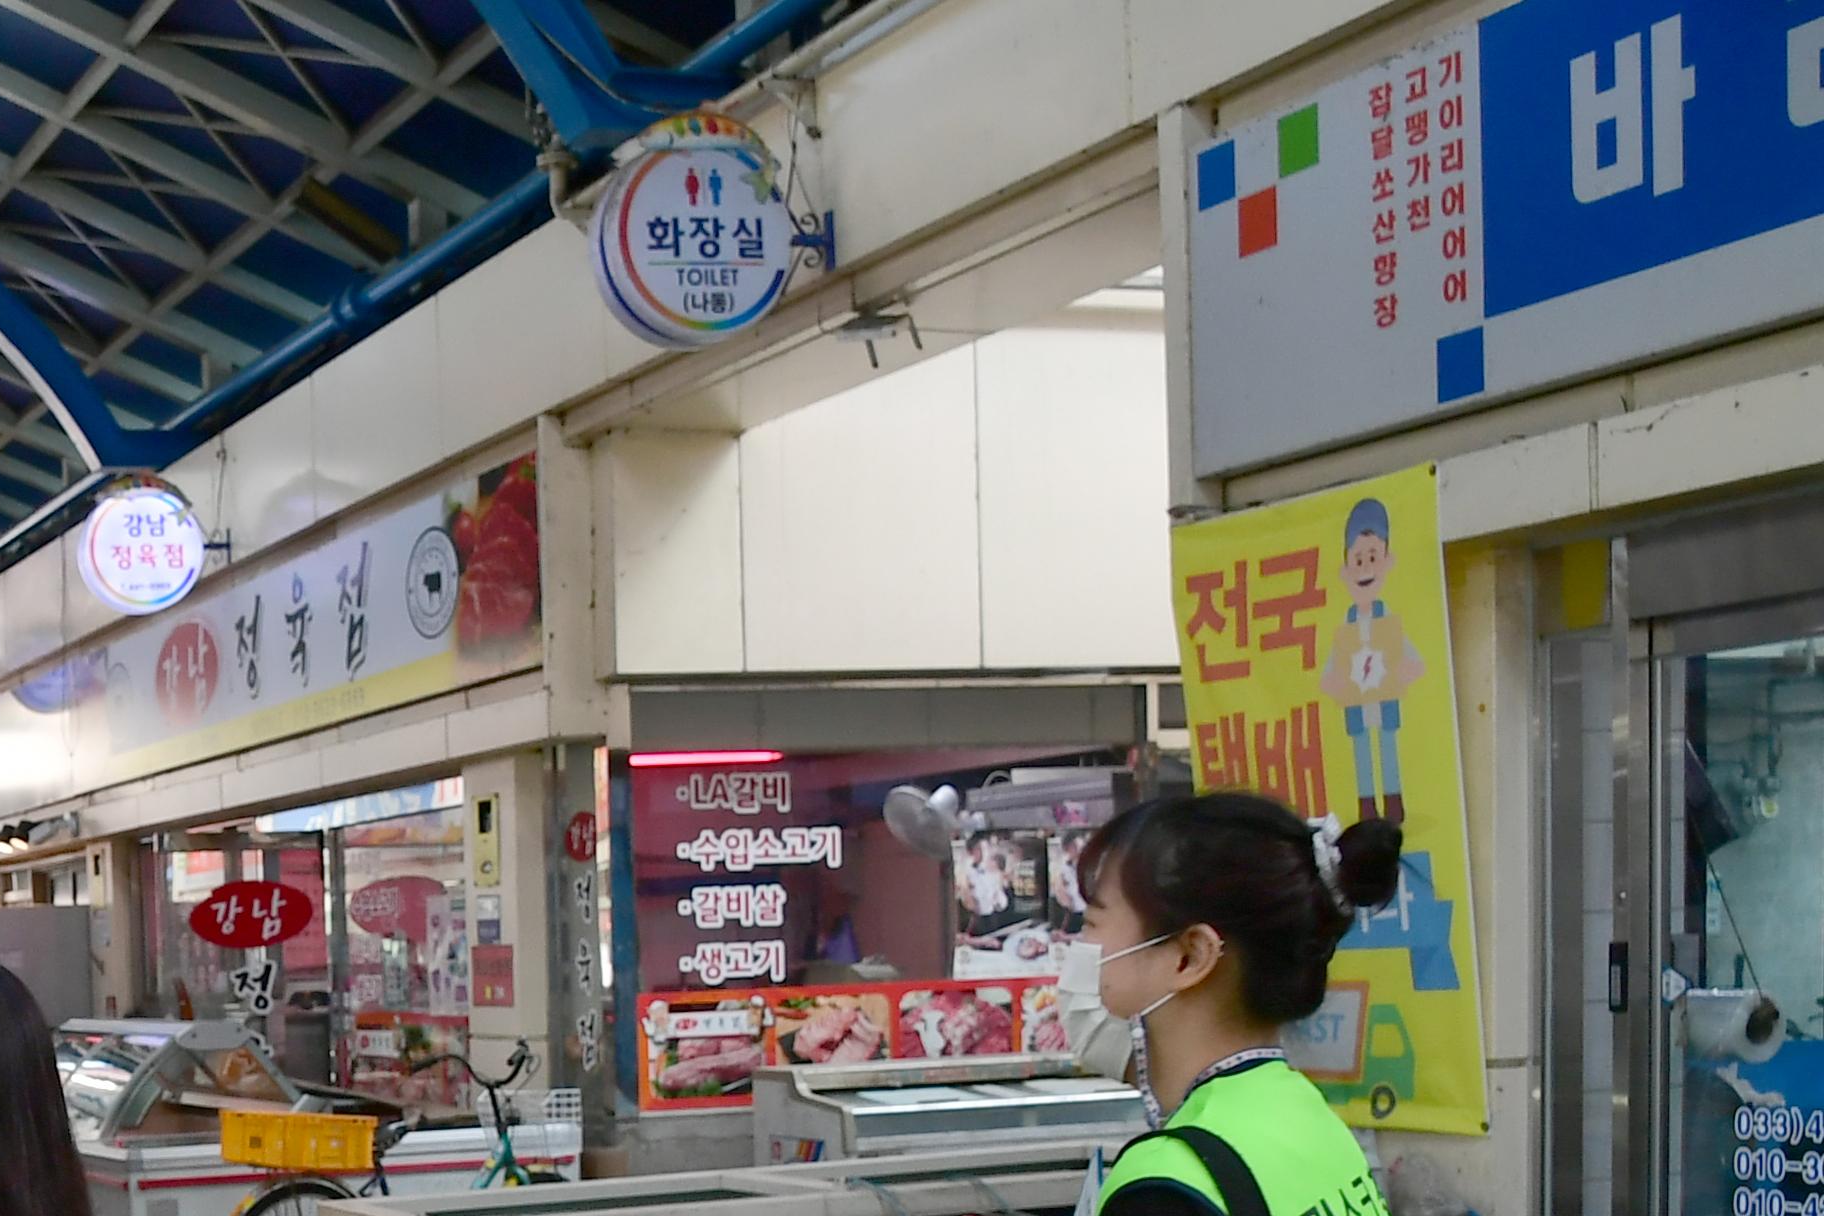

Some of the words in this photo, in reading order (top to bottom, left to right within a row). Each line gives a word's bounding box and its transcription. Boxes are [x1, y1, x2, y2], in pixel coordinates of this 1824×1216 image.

[646, 215, 765, 260] 화장실
[677, 268, 738, 288] TOILET
[123, 513, 165, 538] 강남
[111, 543, 185, 571] 정육점
[234, 540, 369, 699] 정육점
[1185, 546, 1327, 684] 전국
[690, 772, 792, 814] LA갈비
[688, 825, 844, 871] 수입소고기
[210, 888, 287, 941] 강남
[691, 883, 787, 928] 갈비살
[695, 939, 788, 986] 생고기
[1733, 1145, 1824, 1185] 010-3
